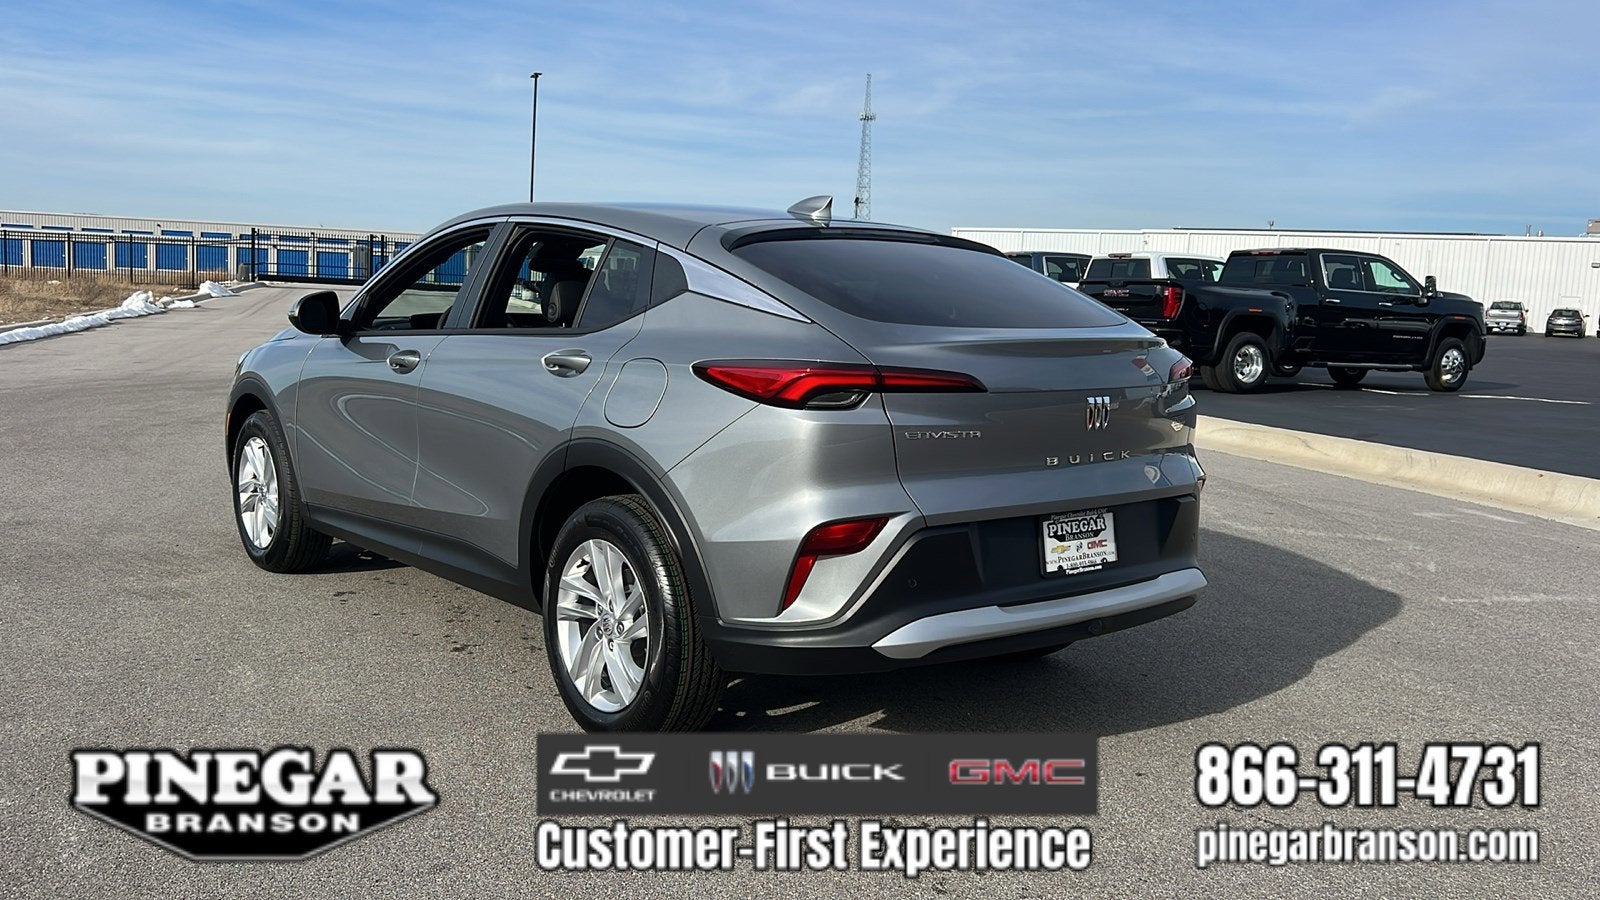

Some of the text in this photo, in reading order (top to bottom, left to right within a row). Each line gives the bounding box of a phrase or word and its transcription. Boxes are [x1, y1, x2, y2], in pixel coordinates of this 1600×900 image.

[1046, 450, 1132, 466] BUICK
[1049, 519, 1106, 536] PINEGAR
[1065, 532, 1095, 541] BRANSON
[1087, 539, 1107, 550] GMC
